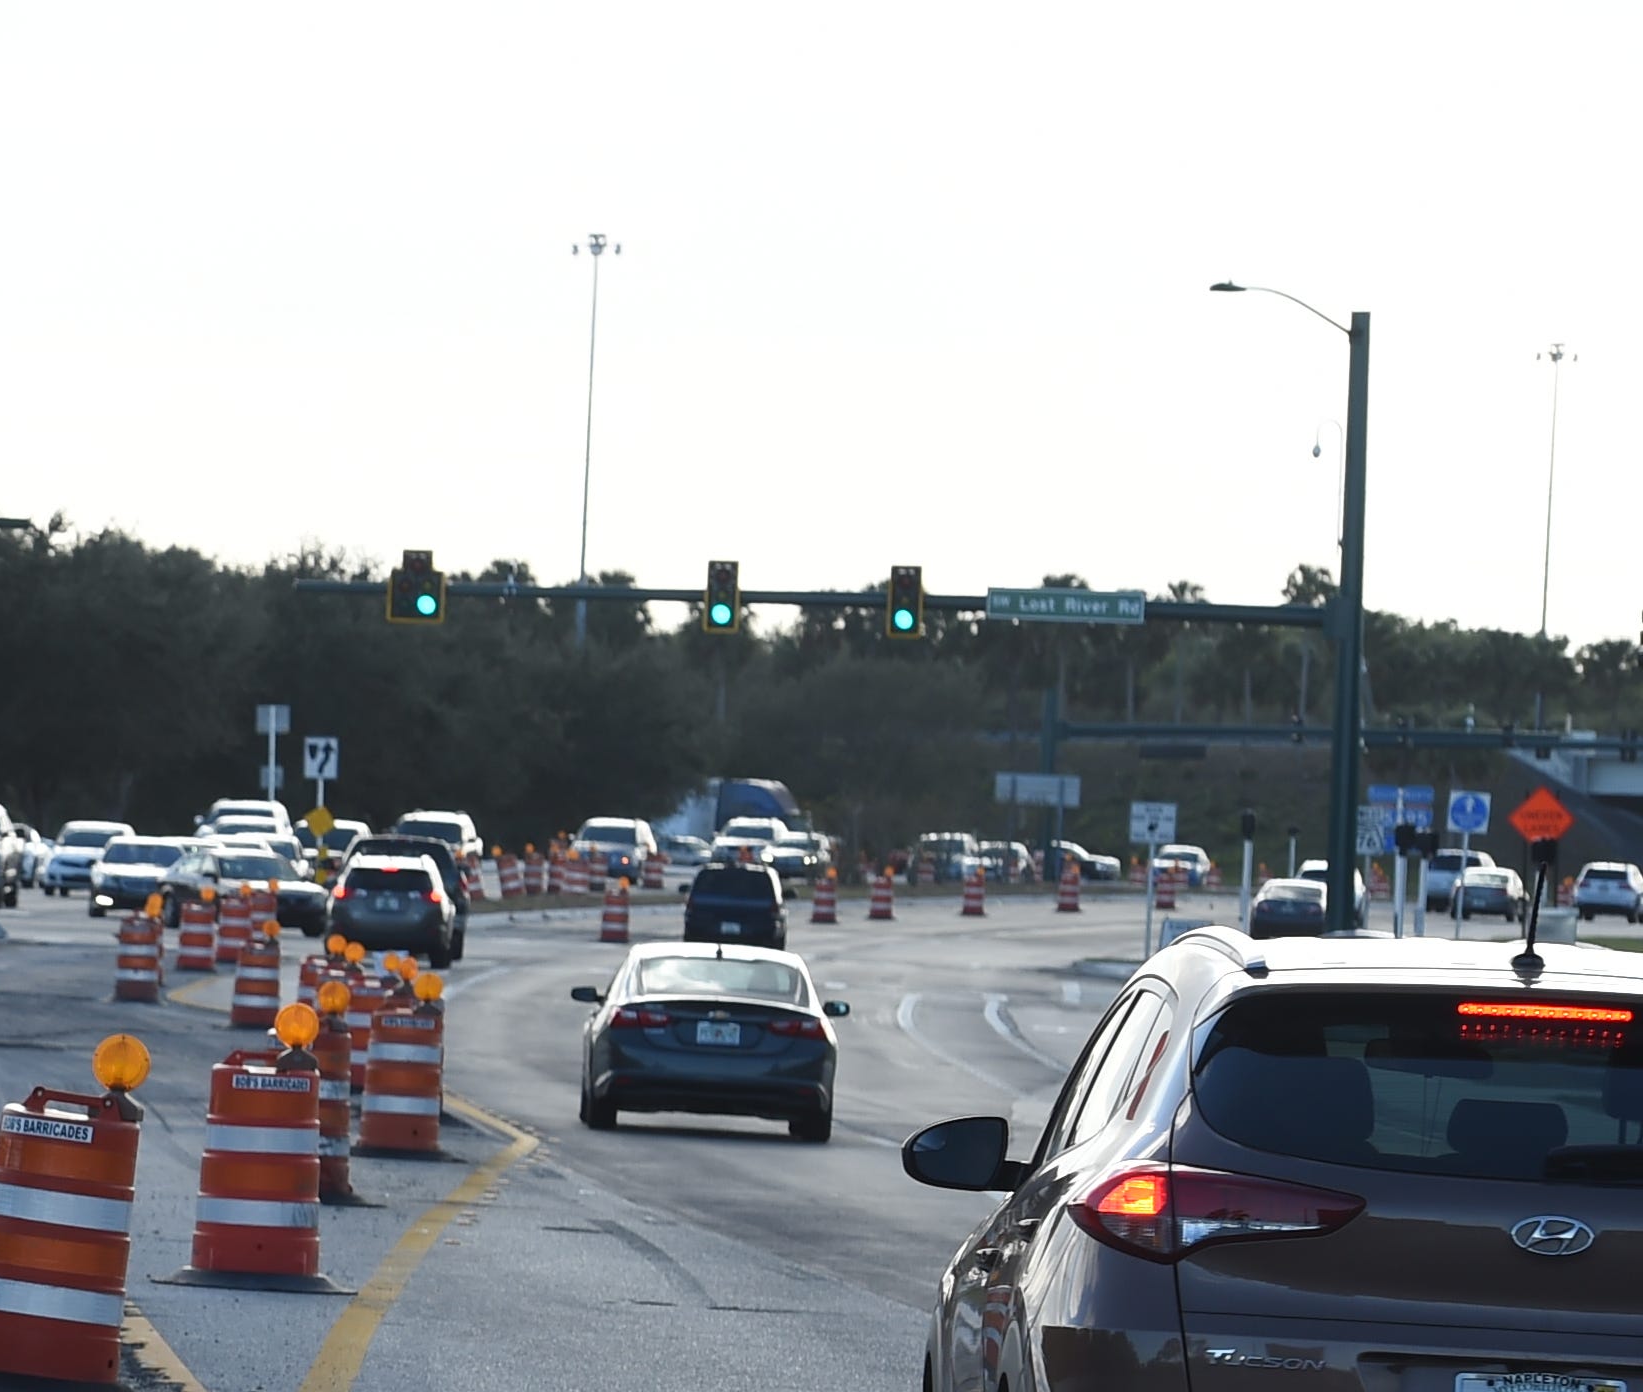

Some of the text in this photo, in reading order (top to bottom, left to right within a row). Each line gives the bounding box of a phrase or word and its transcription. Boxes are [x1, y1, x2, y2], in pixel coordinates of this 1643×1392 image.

[1018, 596, 1055, 613] Lost
[1065, 597, 1109, 614] River
[1117, 599, 1140, 616] Rd
[22, 1118, 89, 1141] BARRICADES
[1205, 1348, 1326, 1371] TUCSON
[1502, 1373, 1581, 1389] NAPLETON
